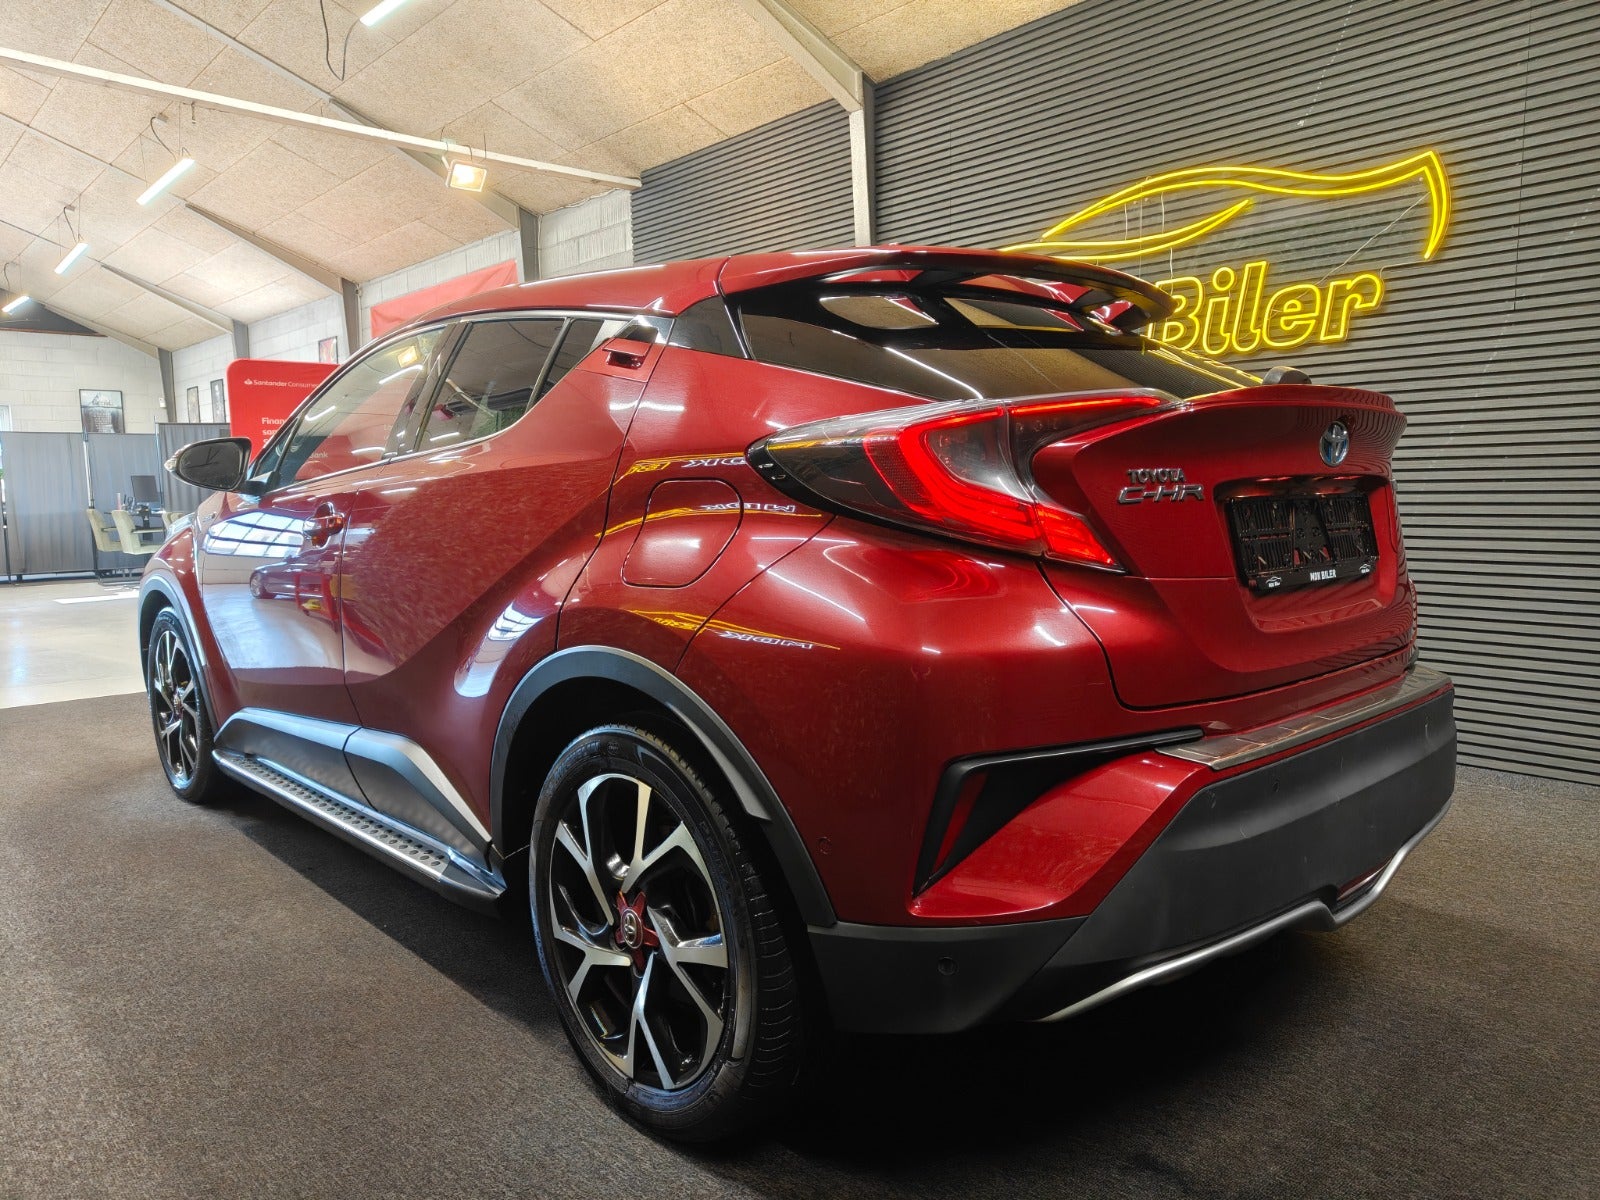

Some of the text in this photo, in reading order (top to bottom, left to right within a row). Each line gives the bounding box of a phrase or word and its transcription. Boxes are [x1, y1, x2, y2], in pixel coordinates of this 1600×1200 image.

[1149, 260, 1383, 355] Biler
[253, 379, 287, 387] Santander
[261, 417, 286, 425] Finan
[1127, 468, 1186, 484] TOYOTA
[1117, 484, 1204, 504] C-HR
